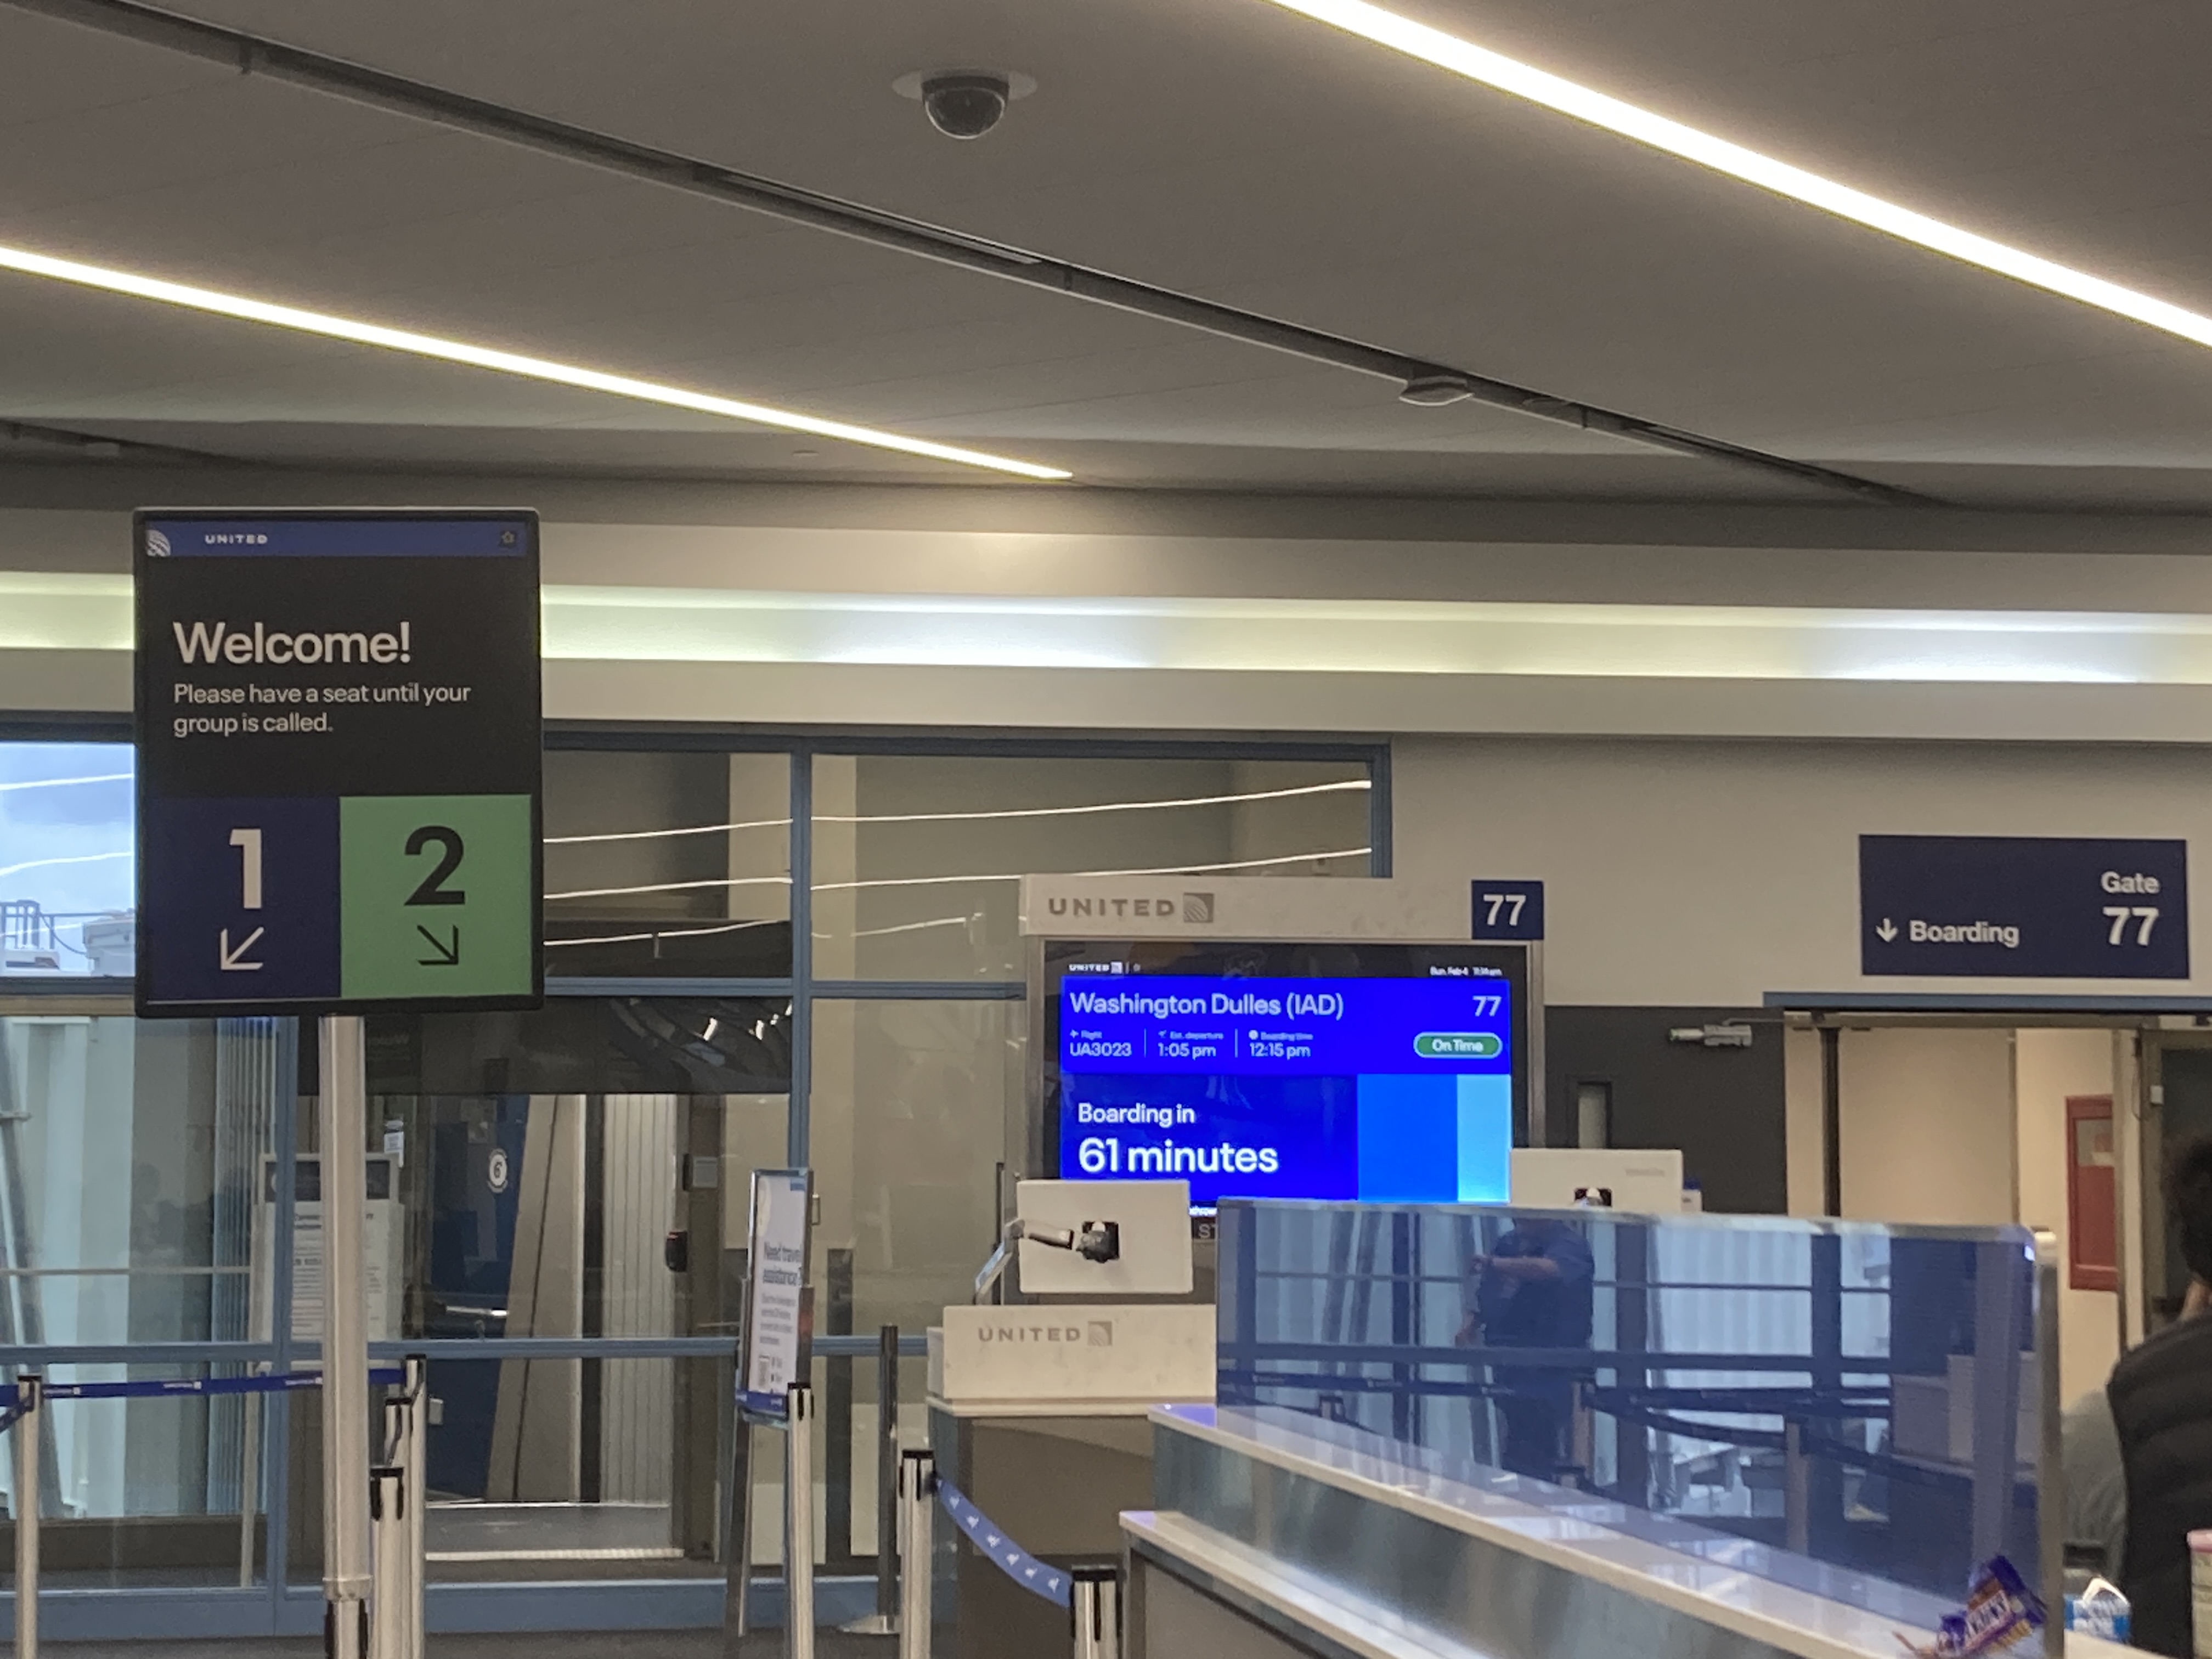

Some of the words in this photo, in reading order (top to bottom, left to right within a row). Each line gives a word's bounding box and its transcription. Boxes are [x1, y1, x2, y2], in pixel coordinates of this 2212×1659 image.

[205, 534, 267, 544] UNITED
[173, 622, 410, 663] Welcome!
[175, 684, 245, 703] Please
[250, 684, 301, 703] have
[306, 689, 318, 702] a
[324, 686, 369, 702] seat
[374, 683, 419, 702] until
[423, 687, 471, 706] your
[174, 718, 238, 737] group
[243, 713, 258, 732] is
[263, 713, 332, 732] called.
[230, 829, 261, 909] 1
[404, 826, 465, 906] 2
[2102, 872, 2159, 893] Gate
[1049, 899, 1175, 917] UNITED
[1483, 894, 1526, 926] 77
[1910, 921, 2019, 947] Boarding
[2103, 907, 2158, 945] 77
[1070, 992, 1206, 1019] Washington
[1212, 993, 1281, 1015] Dulles
[1286, 992, 1343, 1020] (IAD)
[1473, 996, 1501, 1016] 77
[1070, 1042, 1132, 1056] UA3023
[1158, 1043, 1189, 1057] 1:05
[1193, 1047, 1216, 1060] pm
[1250, 1042, 1284, 1057] 12:15
[1286, 1047, 1310, 1059] pm
[1432, 1039, 1451, 1052] On
[1453, 1039, 1484, 1052] Time
[1079, 1103, 1172, 1127] Boarding
[1176, 1104, 1195, 1123] in
[1079, 1138, 1118, 1172] 61
[1128, 1139, 1278, 1172] minutes
[978, 1327, 1080, 1342] UNITED
